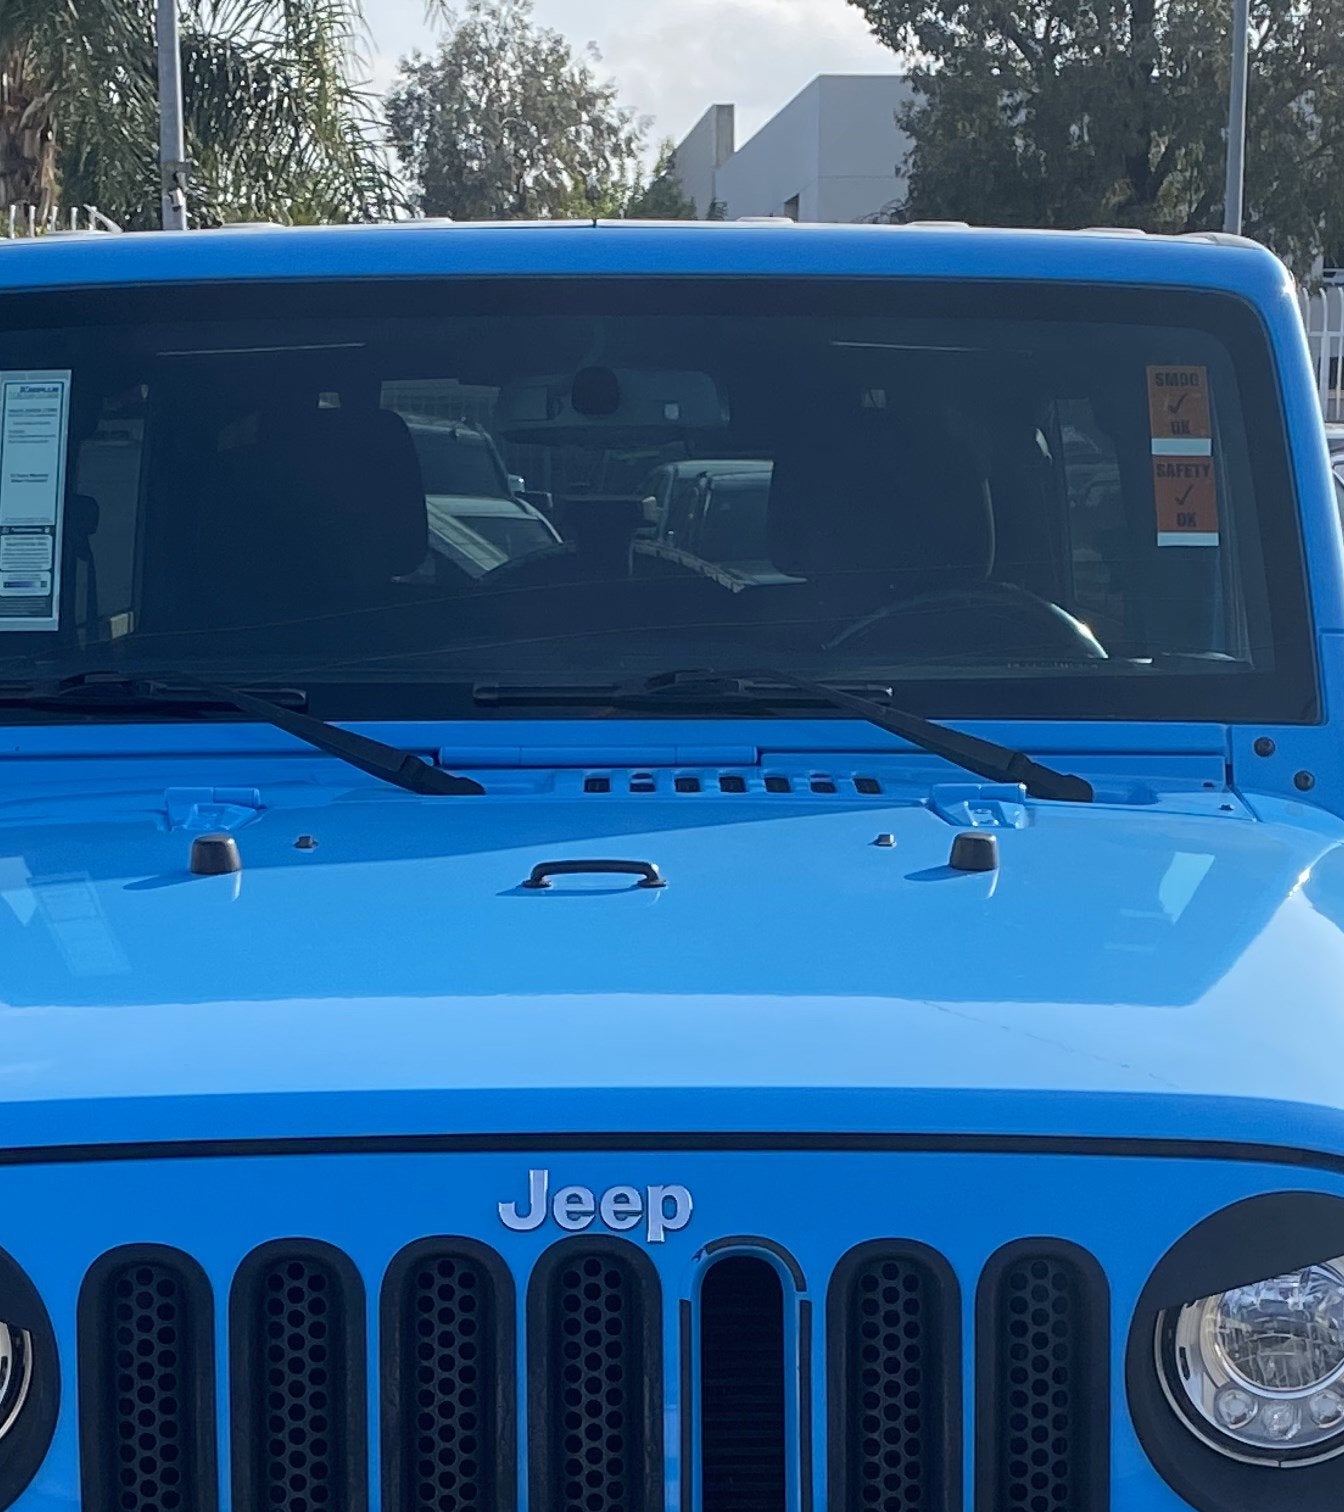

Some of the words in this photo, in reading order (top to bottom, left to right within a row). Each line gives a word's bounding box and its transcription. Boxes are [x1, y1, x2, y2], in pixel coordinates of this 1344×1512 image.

[1155, 372, 1200, 387] SMOG
[1156, 462, 1211, 478] SAFETY
[1176, 512, 1197, 528] OK
[498, 1168, 693, 1243] Jeep
